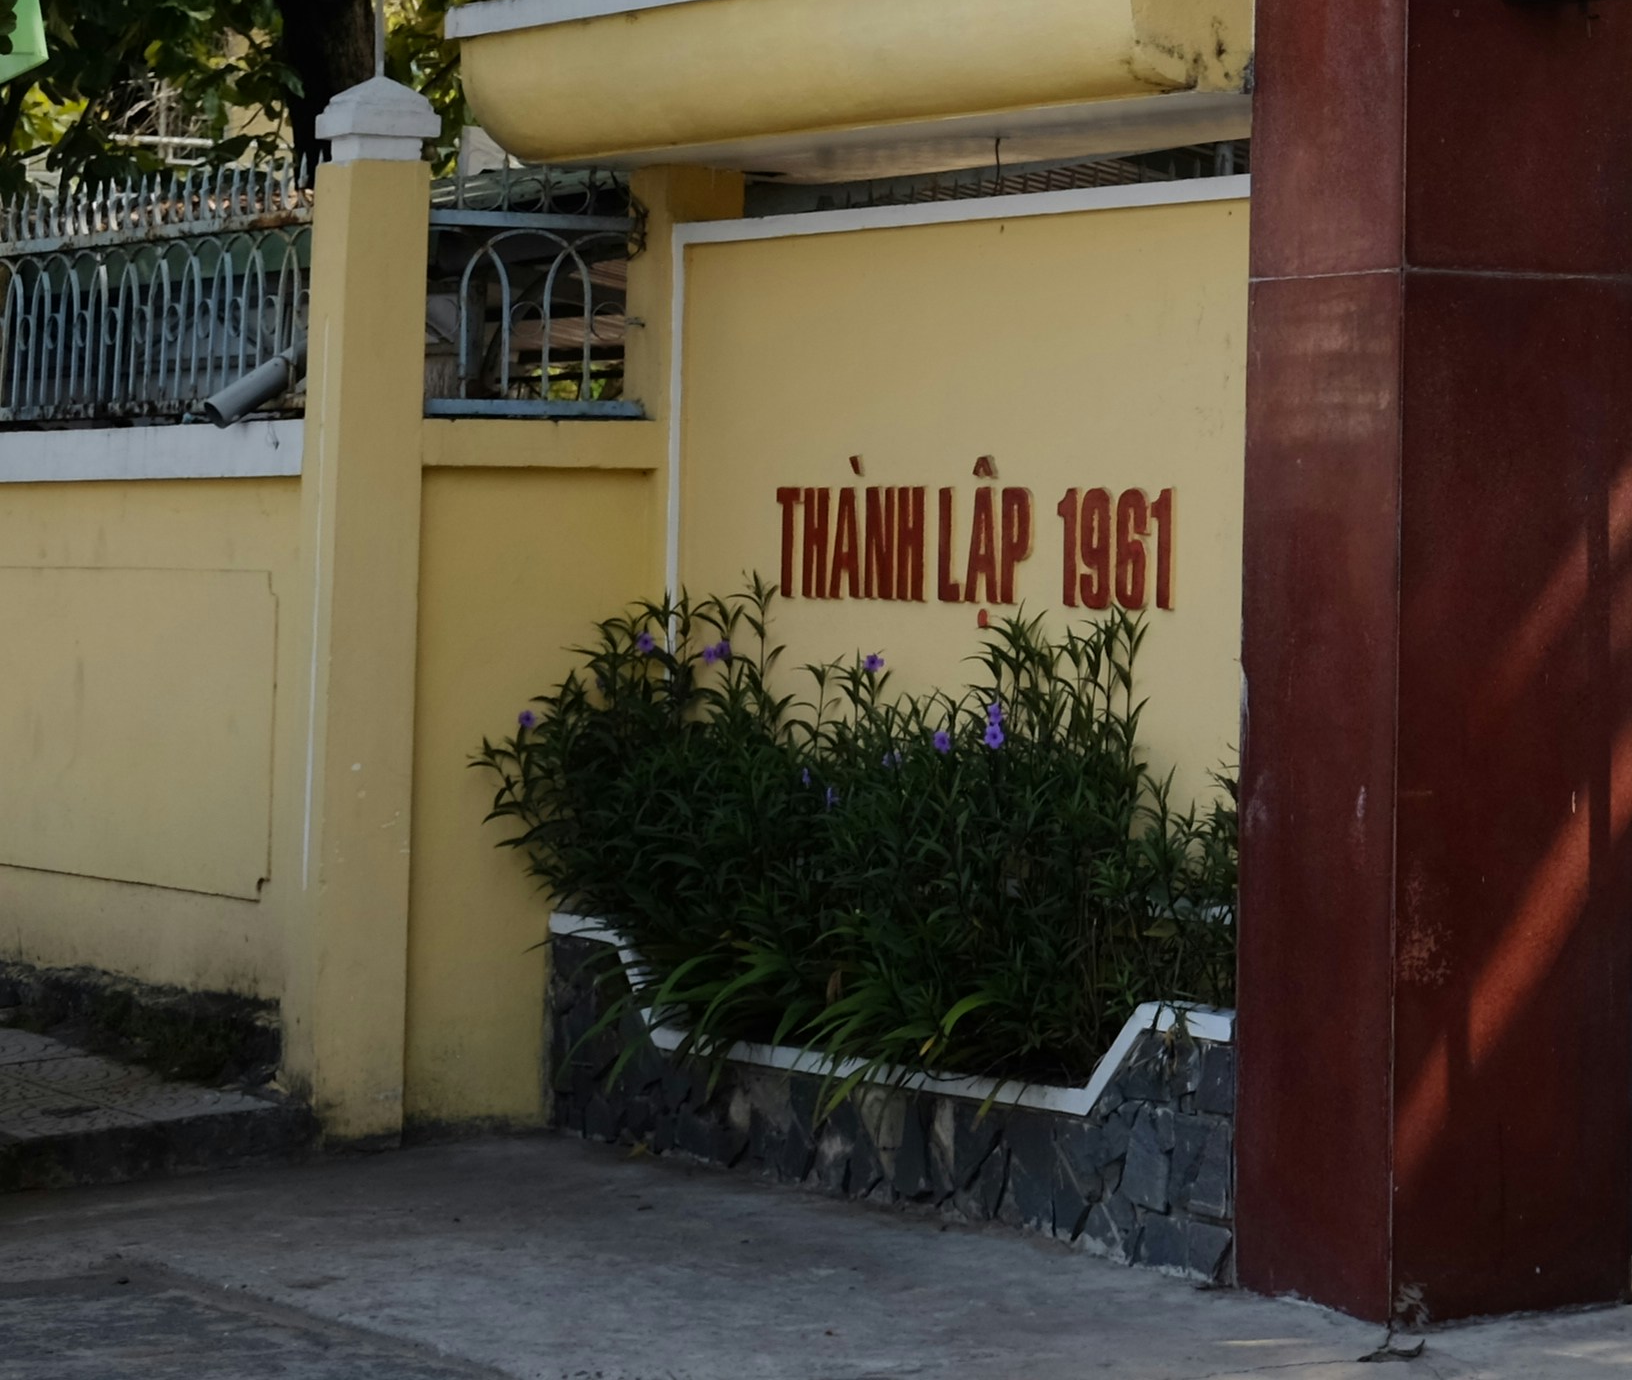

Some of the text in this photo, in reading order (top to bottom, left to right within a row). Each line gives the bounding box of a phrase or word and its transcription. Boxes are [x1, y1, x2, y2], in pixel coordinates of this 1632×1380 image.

[776, 455, 1177, 629] THÀNH LẬP 1961
